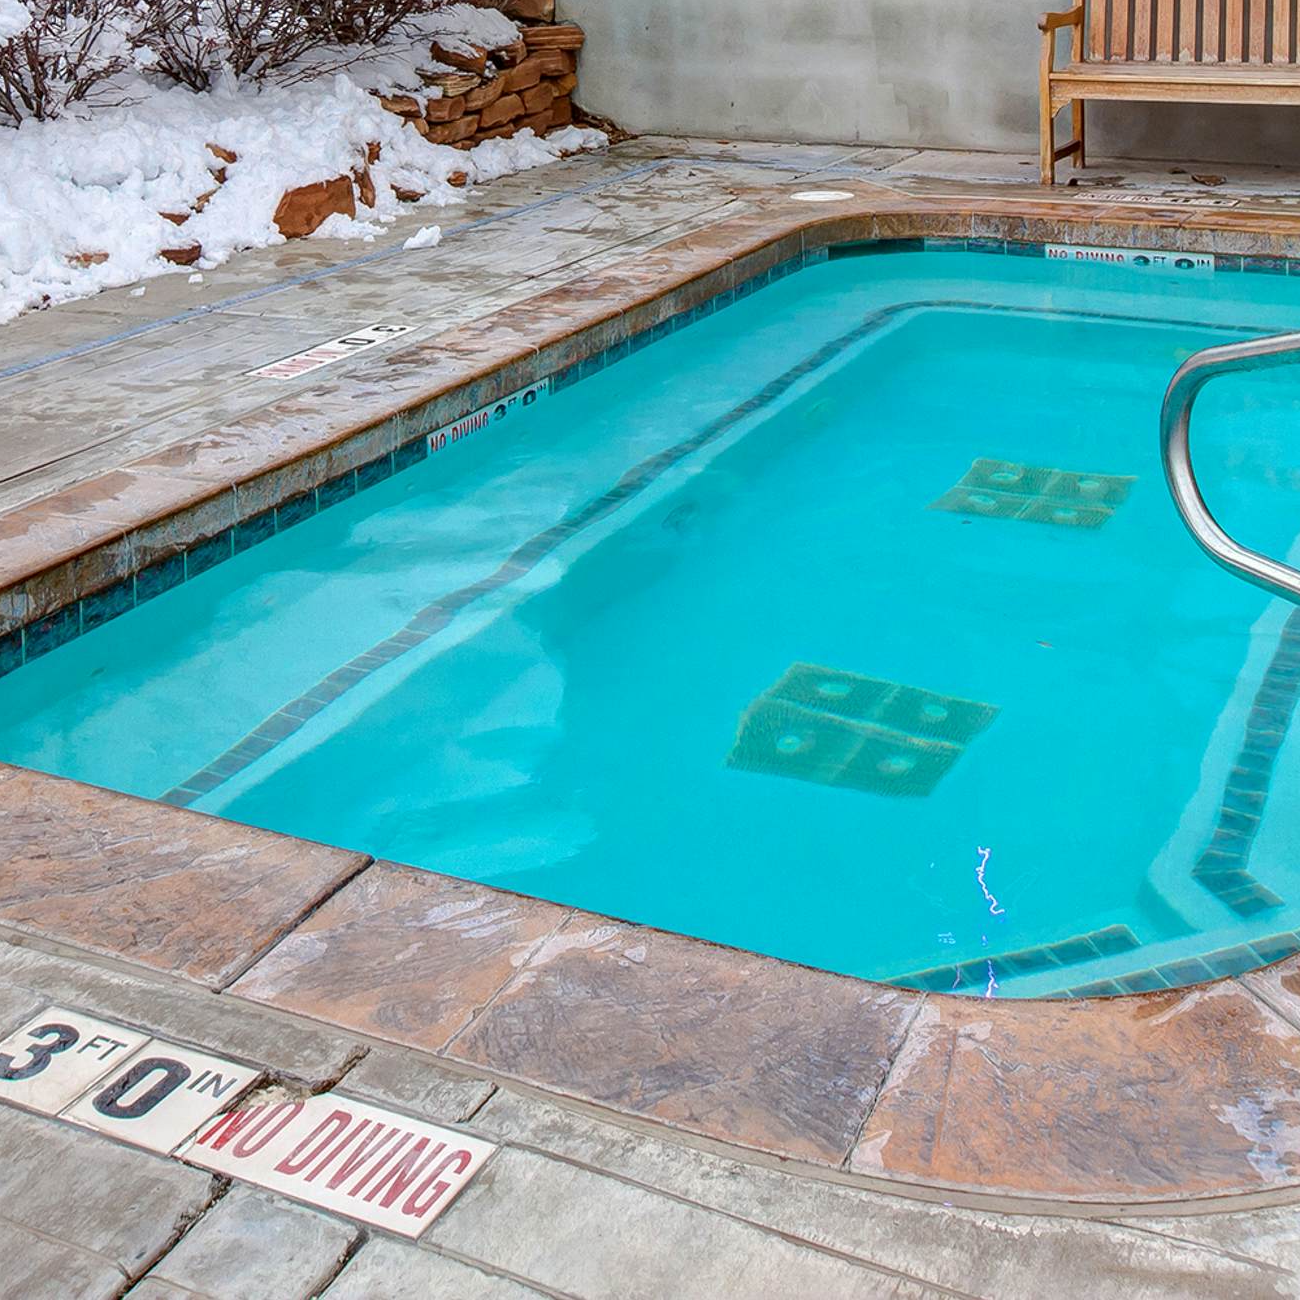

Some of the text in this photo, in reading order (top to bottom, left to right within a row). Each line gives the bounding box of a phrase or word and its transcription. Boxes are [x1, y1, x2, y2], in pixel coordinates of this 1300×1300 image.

[1048, 248, 1068, 260] NO
[430, 433, 446, 452] NO
[452, 412, 489, 444] DIVING
[493, 404, 507, 421] 3
[80, 1034, 129, 1062] FT
[92, 1056, 191, 1119] 0
[186, 1069, 238, 1100] IN
[197, 1100, 473, 1219] NO DIVING
